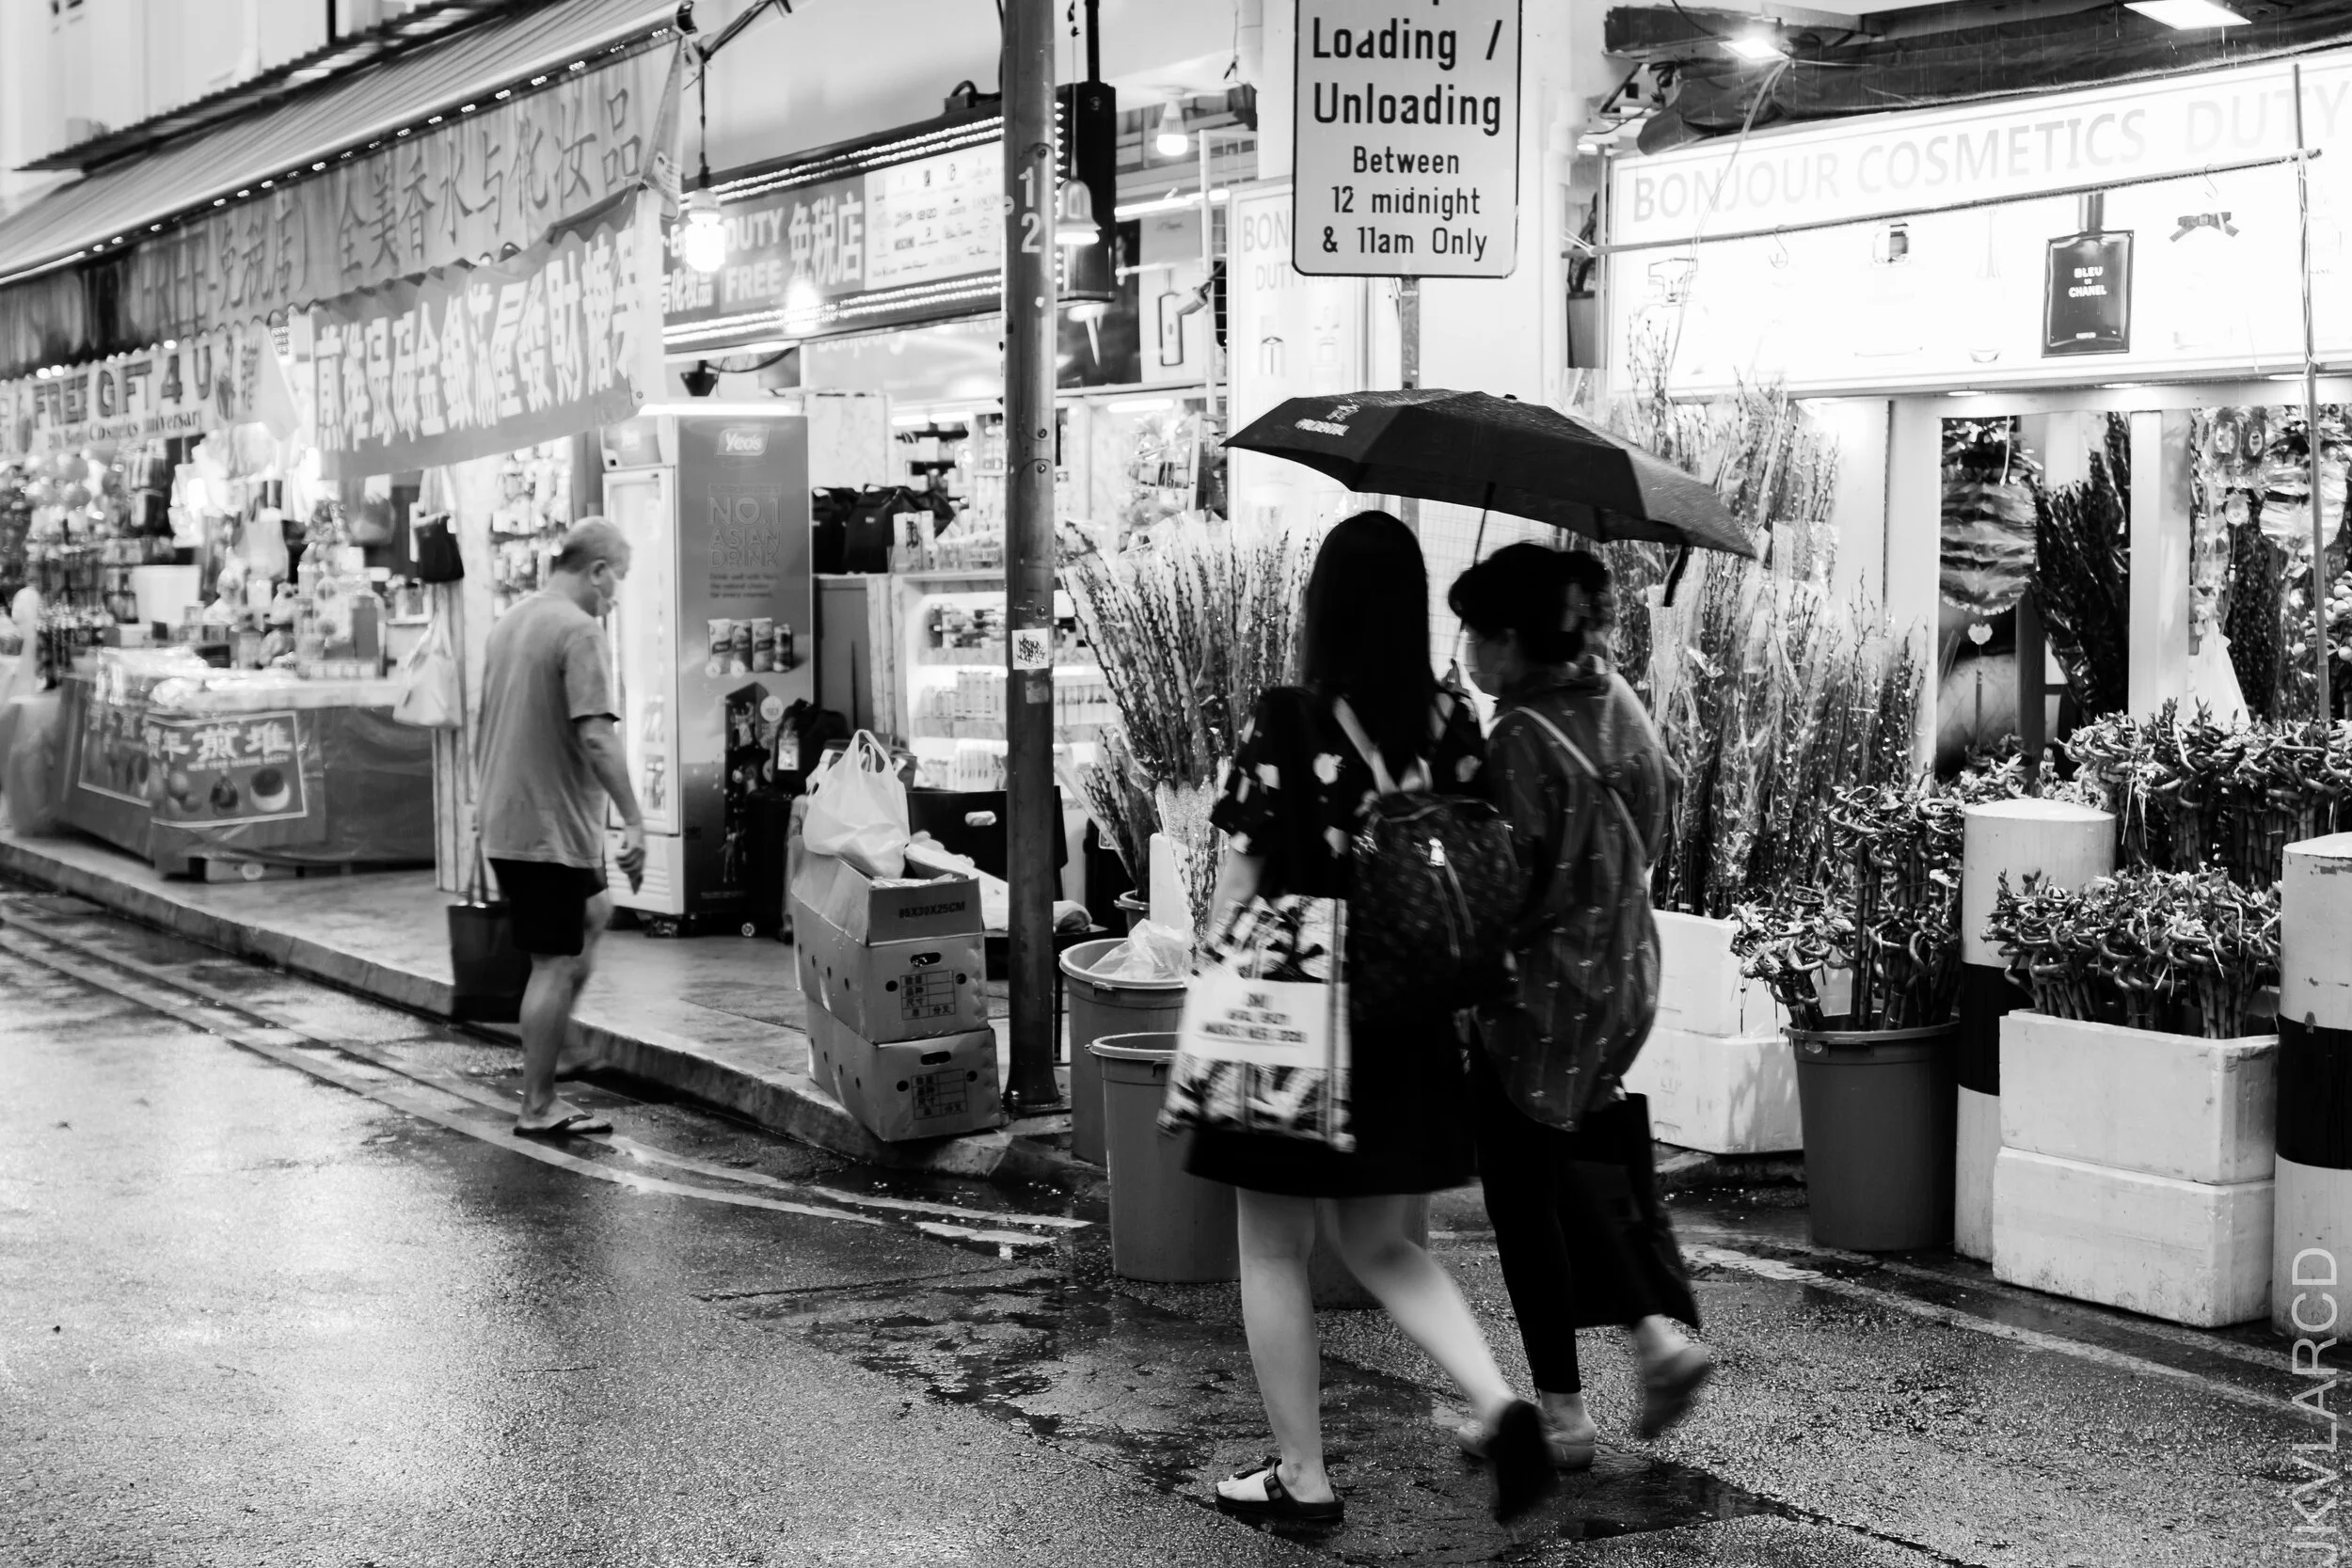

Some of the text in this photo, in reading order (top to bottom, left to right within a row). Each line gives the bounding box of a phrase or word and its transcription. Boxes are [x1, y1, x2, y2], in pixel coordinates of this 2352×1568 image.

[1312, 18, 1503, 71] Loading /
[1313, 82, 1502, 135] Unloading
[1353, 146, 1460, 174] Between
[1633, 80, 2351, 223] BONJOUR COSMETICS DUTY
[1331, 186, 1481, 221] 12 midnight
[723, 207, 785, 252] DUTY
[788, 191, 863, 286] 免税店
[1322, 226, 1488, 261] & 11am Only
[725, 260, 782, 303] FREE
[2074, 266, 2104, 278] BLEU
[2068, 285, 2107, 297] CHANEL
[97, 359, 152, 420] GFT
[725, 432, 763, 451] Yeo's
[707, 496, 781, 525] NO.1
[710, 527, 780, 547] ASIAN
[710, 547, 780, 568] DRINK
